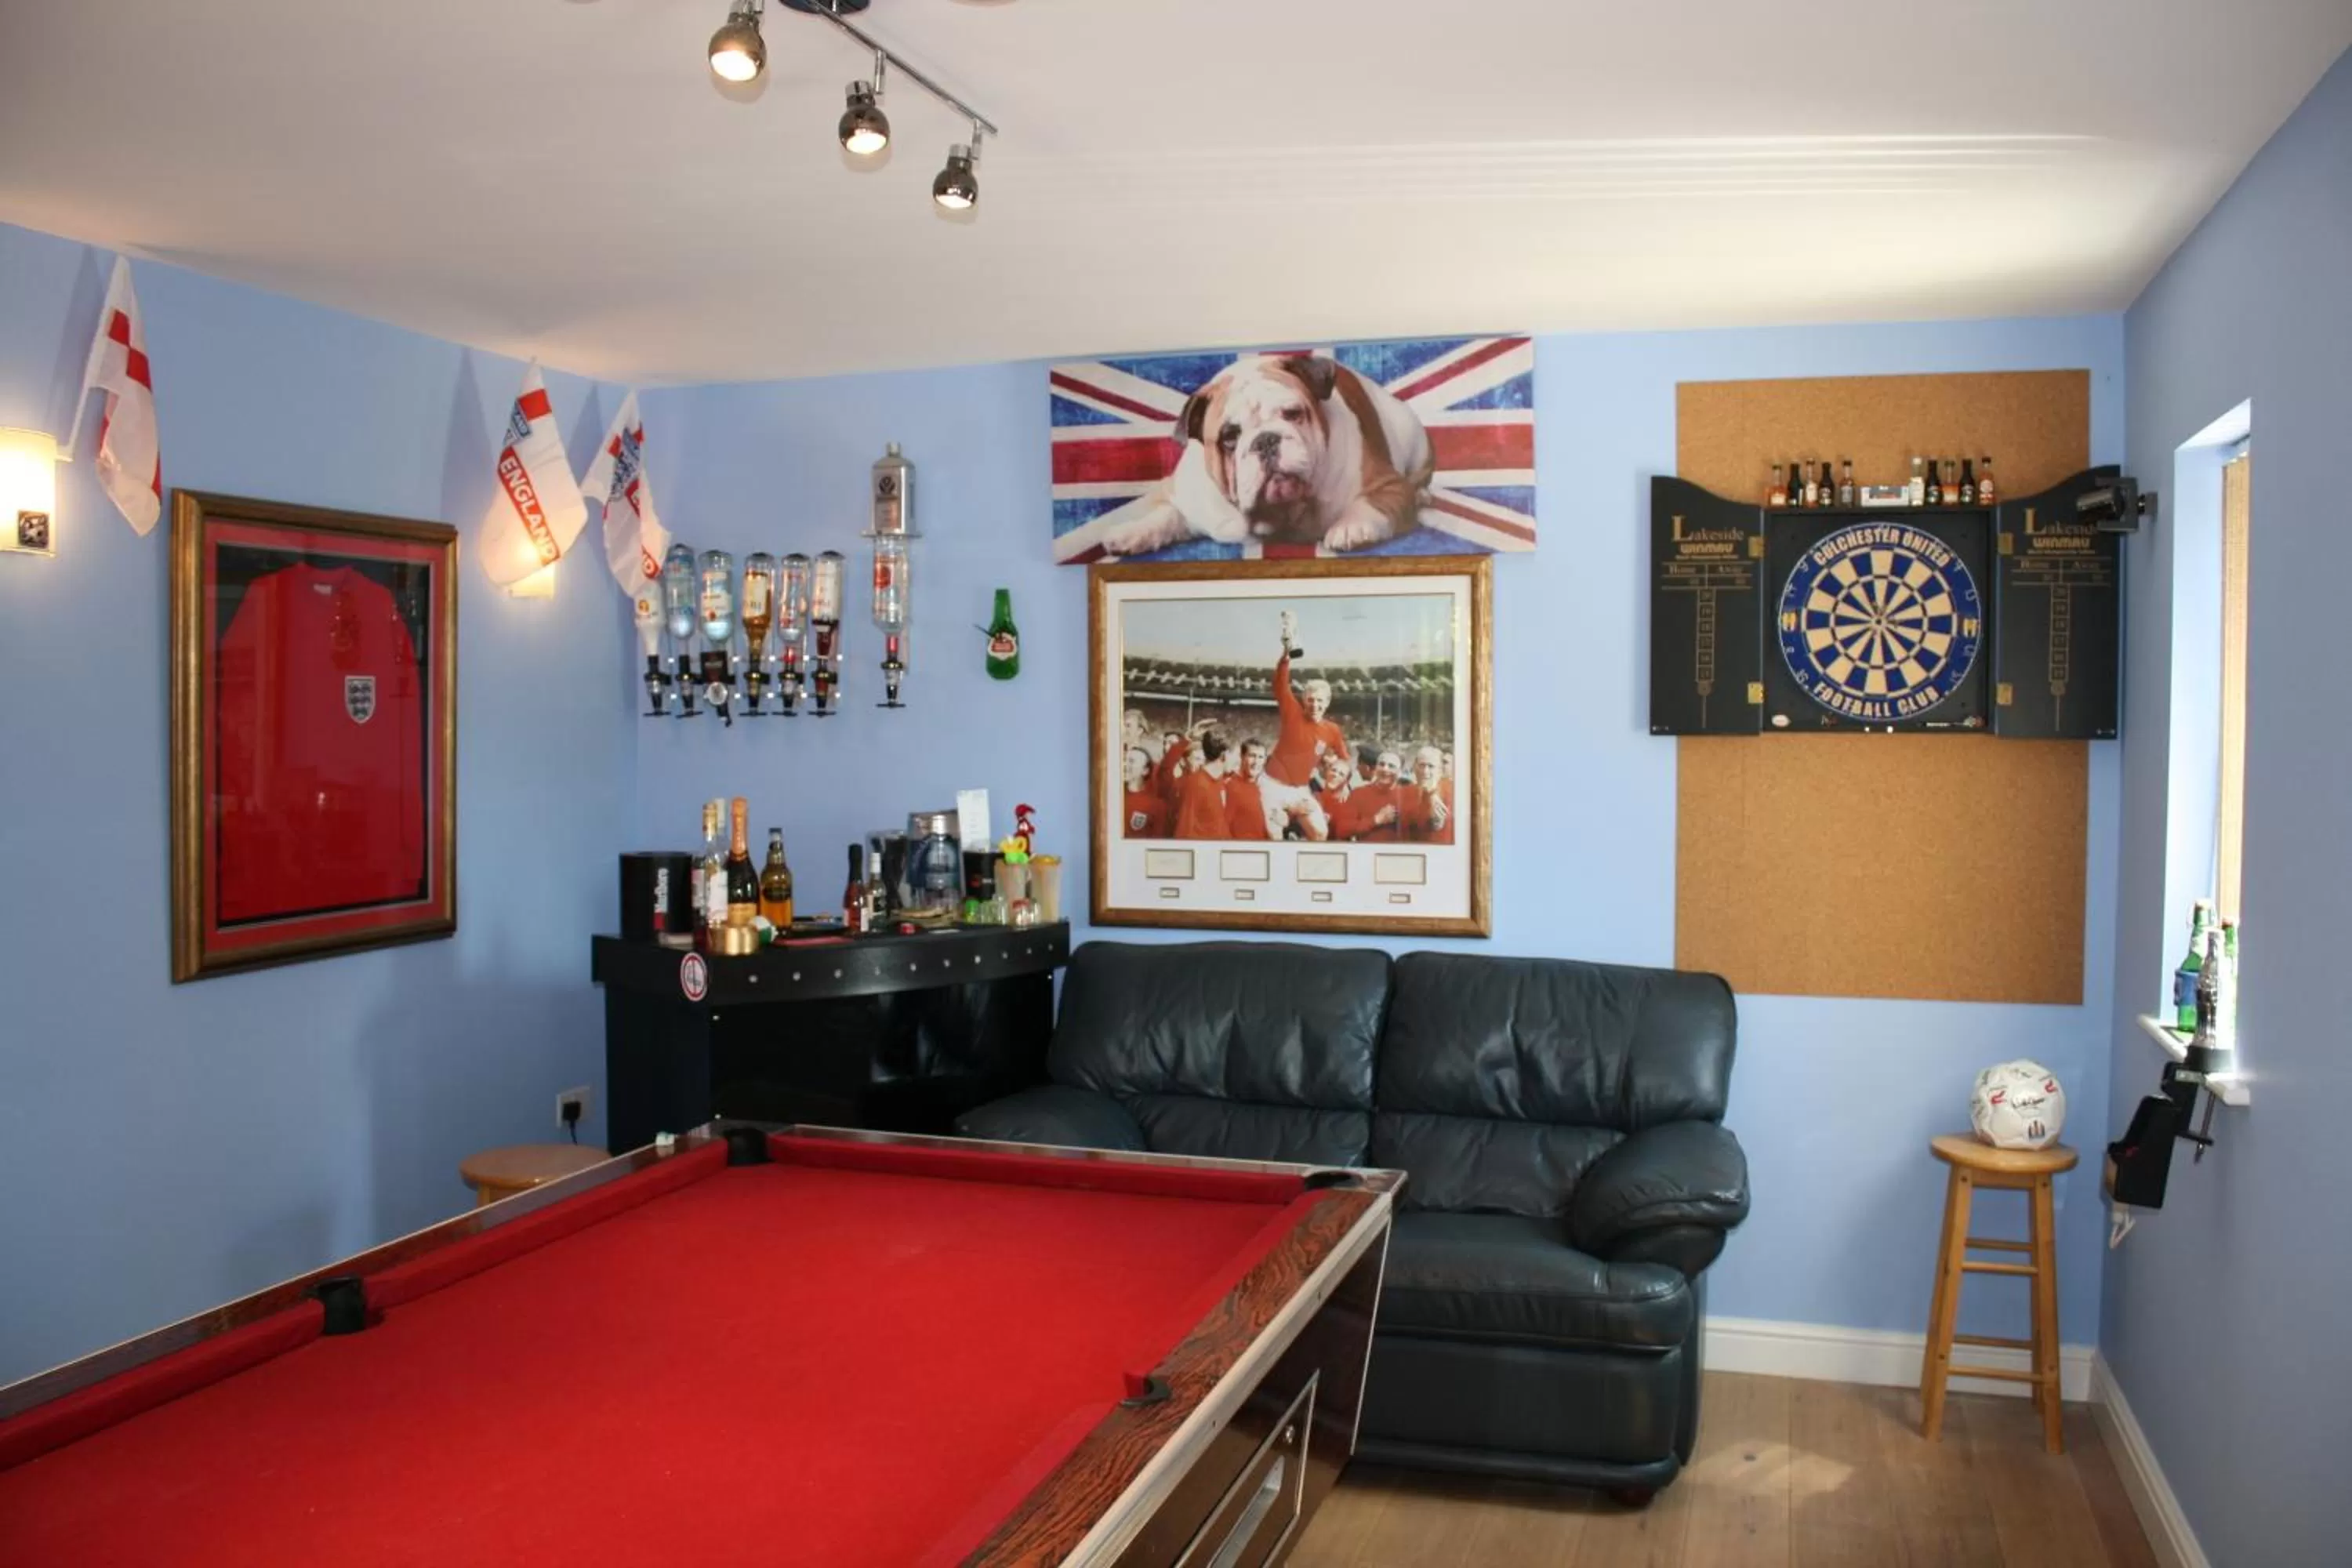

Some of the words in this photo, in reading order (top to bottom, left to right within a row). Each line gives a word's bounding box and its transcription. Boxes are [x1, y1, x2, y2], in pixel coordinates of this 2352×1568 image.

[500, 456, 556, 561] ENGLAND
[1671, 514, 1744, 543] Lakeside
[1813, 525, 1900, 566] COLCHESTER
[1902, 529, 1951, 568] UNITED
[1813, 683, 1892, 717] FOOTBALL
[1897, 686, 1940, 714] CLUB
